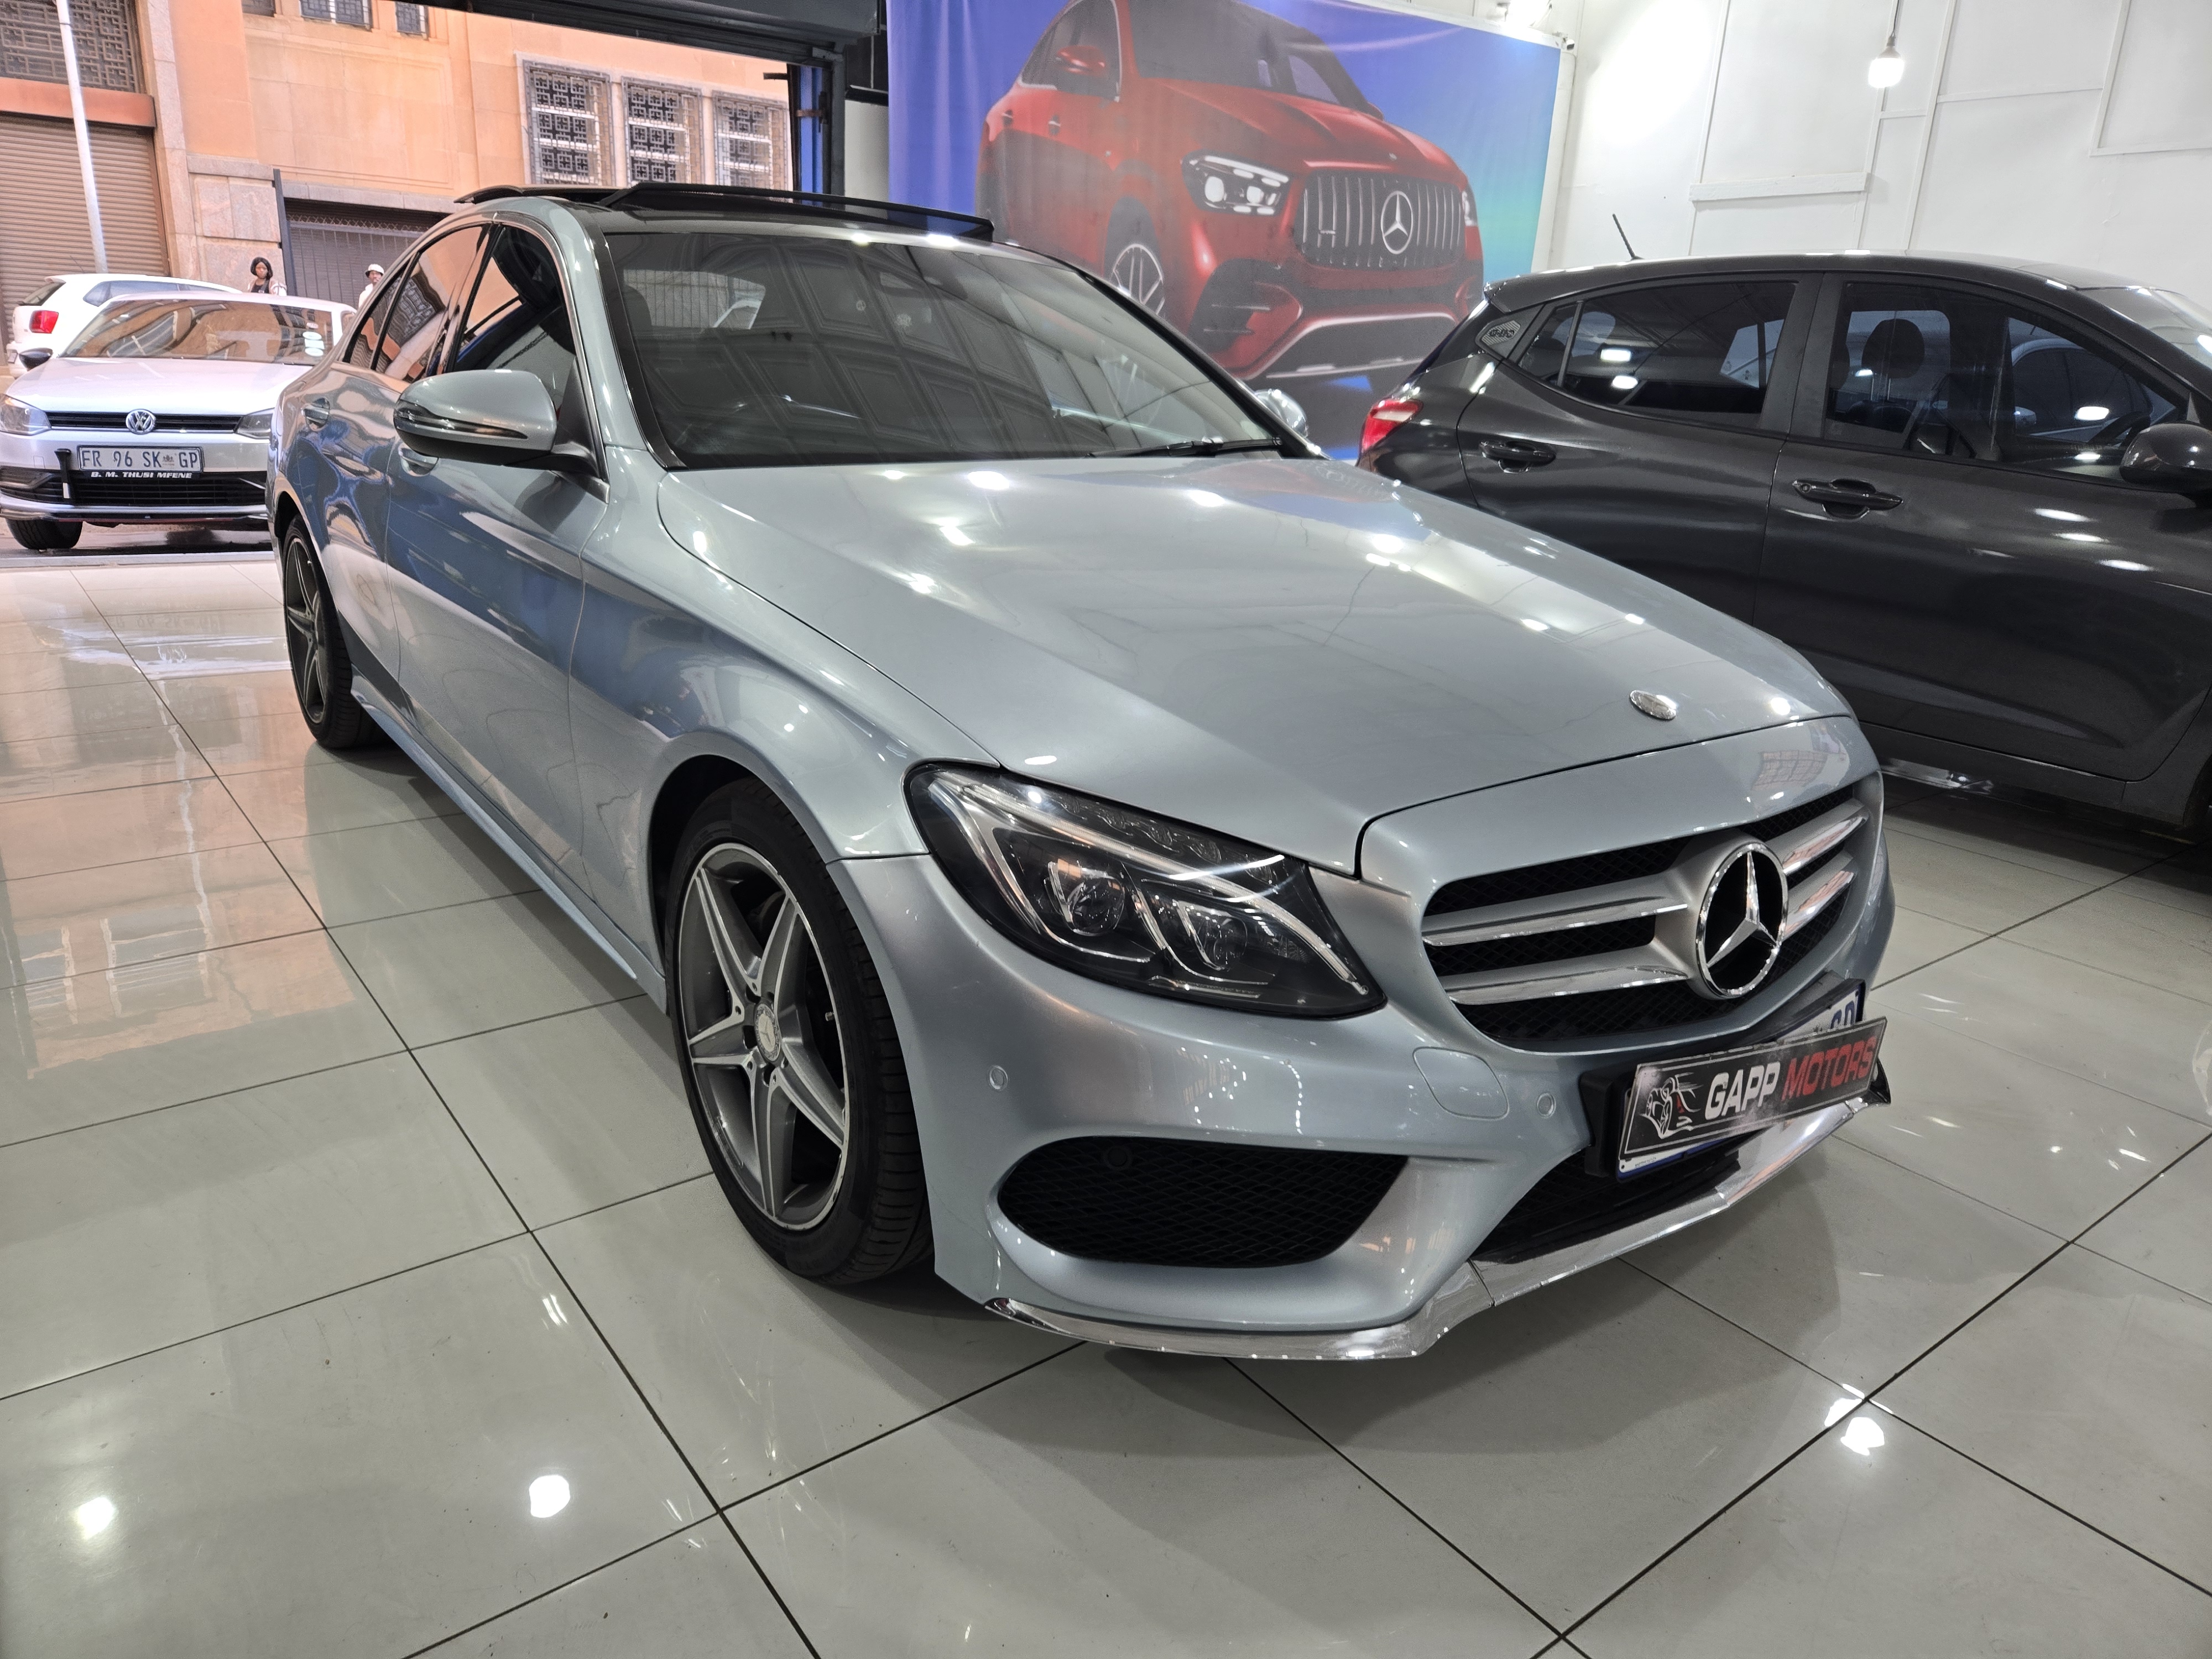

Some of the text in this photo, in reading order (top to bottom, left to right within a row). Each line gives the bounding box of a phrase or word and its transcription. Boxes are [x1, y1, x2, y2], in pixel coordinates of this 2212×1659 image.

[81, 450, 197, 468] FR 96 SK GP
[1705, 1036, 1877, 1120] GAPP MOTORS
